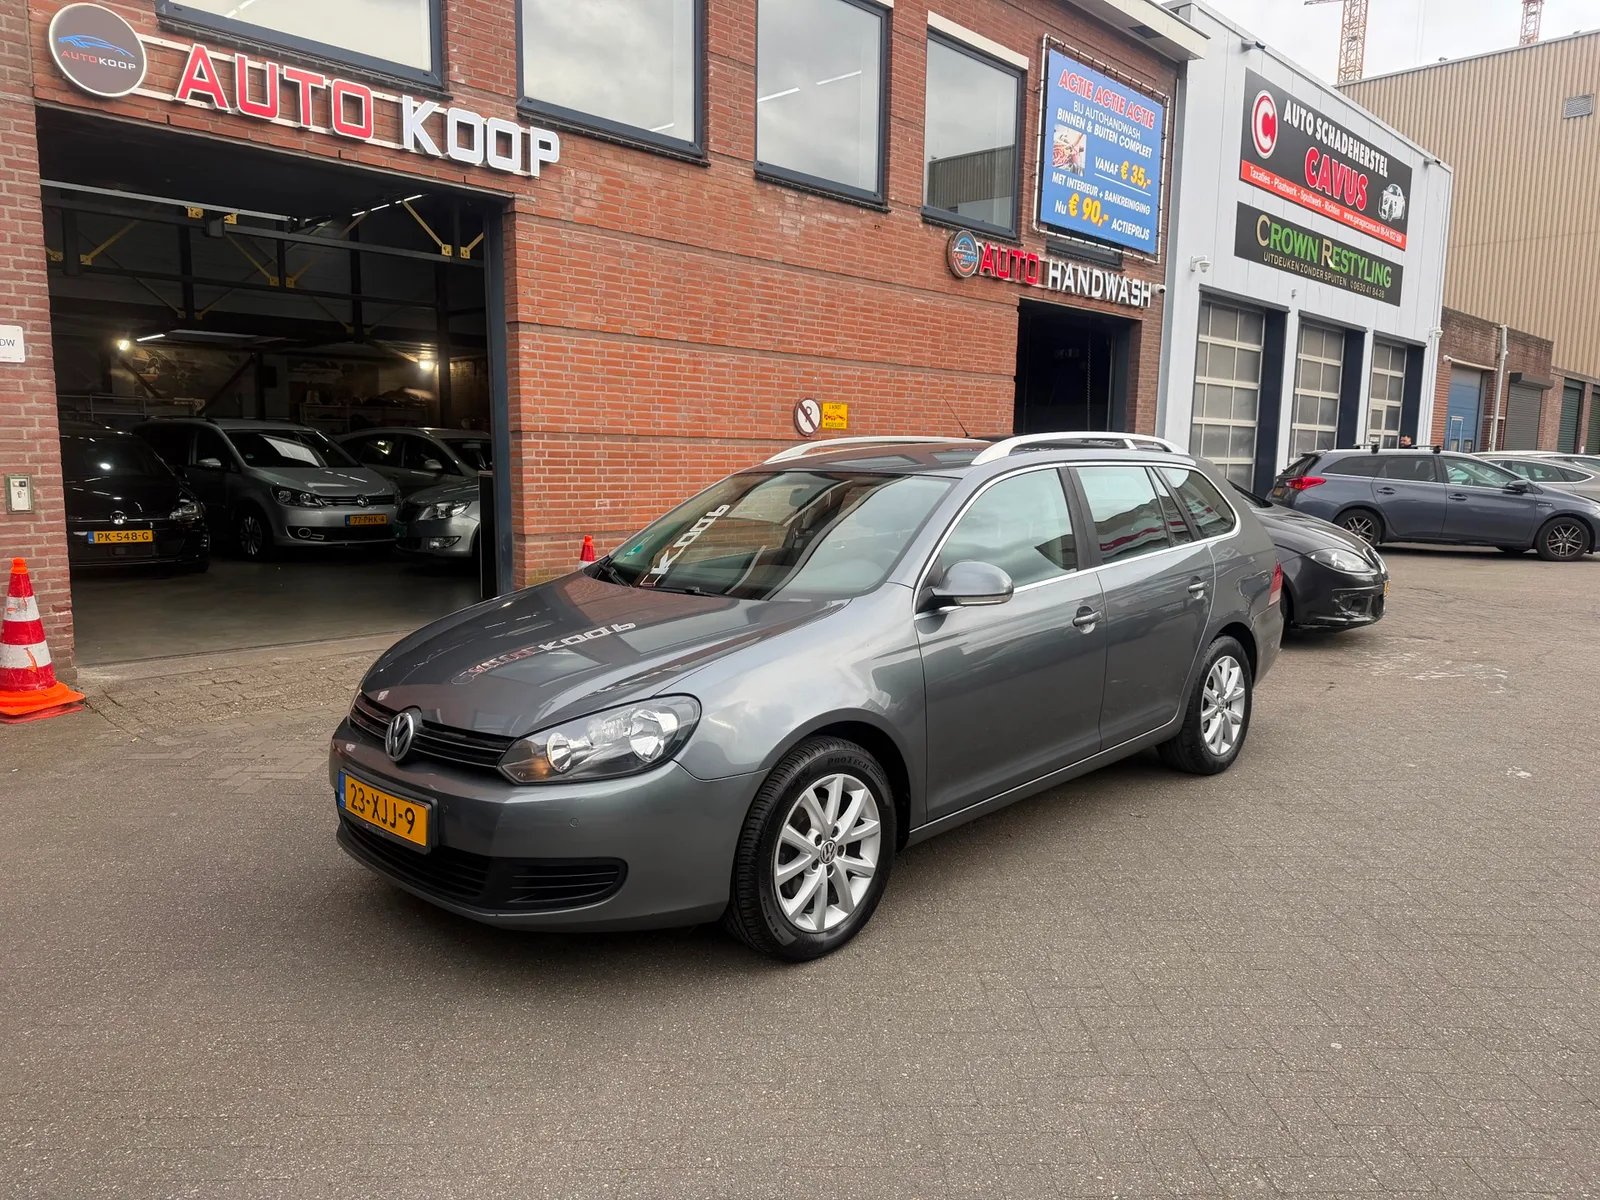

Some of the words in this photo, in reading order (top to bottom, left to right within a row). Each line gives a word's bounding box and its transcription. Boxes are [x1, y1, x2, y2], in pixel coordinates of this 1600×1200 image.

[61, 50, 136, 70] AUTOKOOP
[175, 43, 374, 141] AUTO
[402, 95, 560, 178] KOOP
[1058, 69, 1093, 100] ACTIE
[1093, 86, 1126, 116] ACTIE
[1125, 101, 1155, 129] ACTIE
[1073, 100, 1084, 114] BIJ
[1085, 106, 1141, 140] AUTOHANDWASH
[1057, 108, 1085, 130] BINNEN
[1087, 123, 1093, 133] &
[1093, 124, 1118, 144] BUITEN
[1119, 135, 1152, 159] COMPLEET
[1283, 99, 1314, 136] AUTO
[1315, 117, 1389, 178] SCHADEHERSTEL
[1051, 171, 1066, 186] MET
[1066, 176, 1099, 197] INTERIEUR
[1104, 190, 1151, 215] BANKREINIGING
[1095, 156, 1119, 176] VANAF
[1120, 160, 1129, 180] €
[1305, 146, 1368, 211] CAVUS
[1068, 192, 1080, 217] €
[1111, 218, 1150, 240] ACTIEPRIJS
[979, 242, 1040, 285] AUTO
[1047, 258, 1152, 308] HANDWASH
[1256, 214, 1319, 264] CROWN
[1321, 238, 1392, 288] RESTYLING
[1263, 251, 1300, 272] UITDEUKEN
[1300, 263, 1324, 280] ZONDER
[1324, 271, 1347, 286] SPUITEN
[97, 531, 149, 542] PK-548-G
[350, 783, 416, 834] 23-XJJ-9
